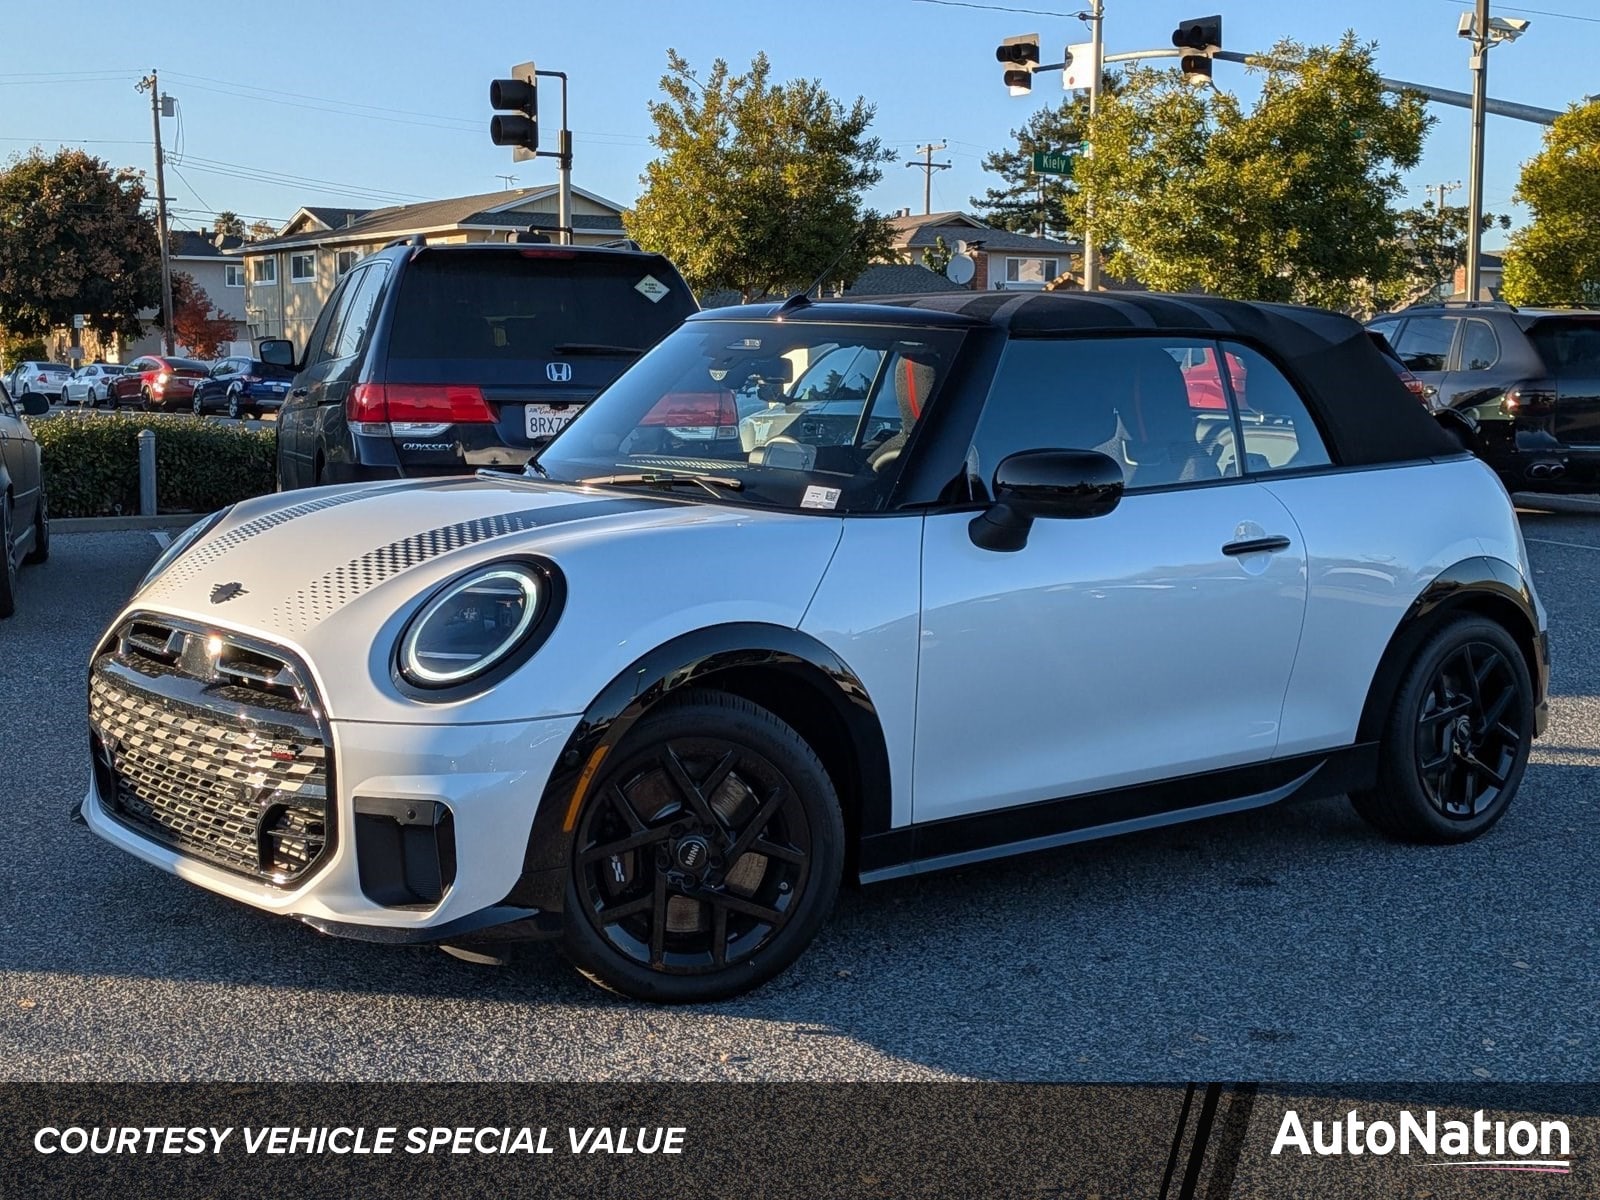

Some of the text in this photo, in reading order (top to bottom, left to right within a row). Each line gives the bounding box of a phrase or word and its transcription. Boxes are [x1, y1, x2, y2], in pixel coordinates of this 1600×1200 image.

[1042, 155, 1066, 173] Kiely
[402, 442, 454, 451] ODYSSEY
[685, 844, 700, 866] MINI
